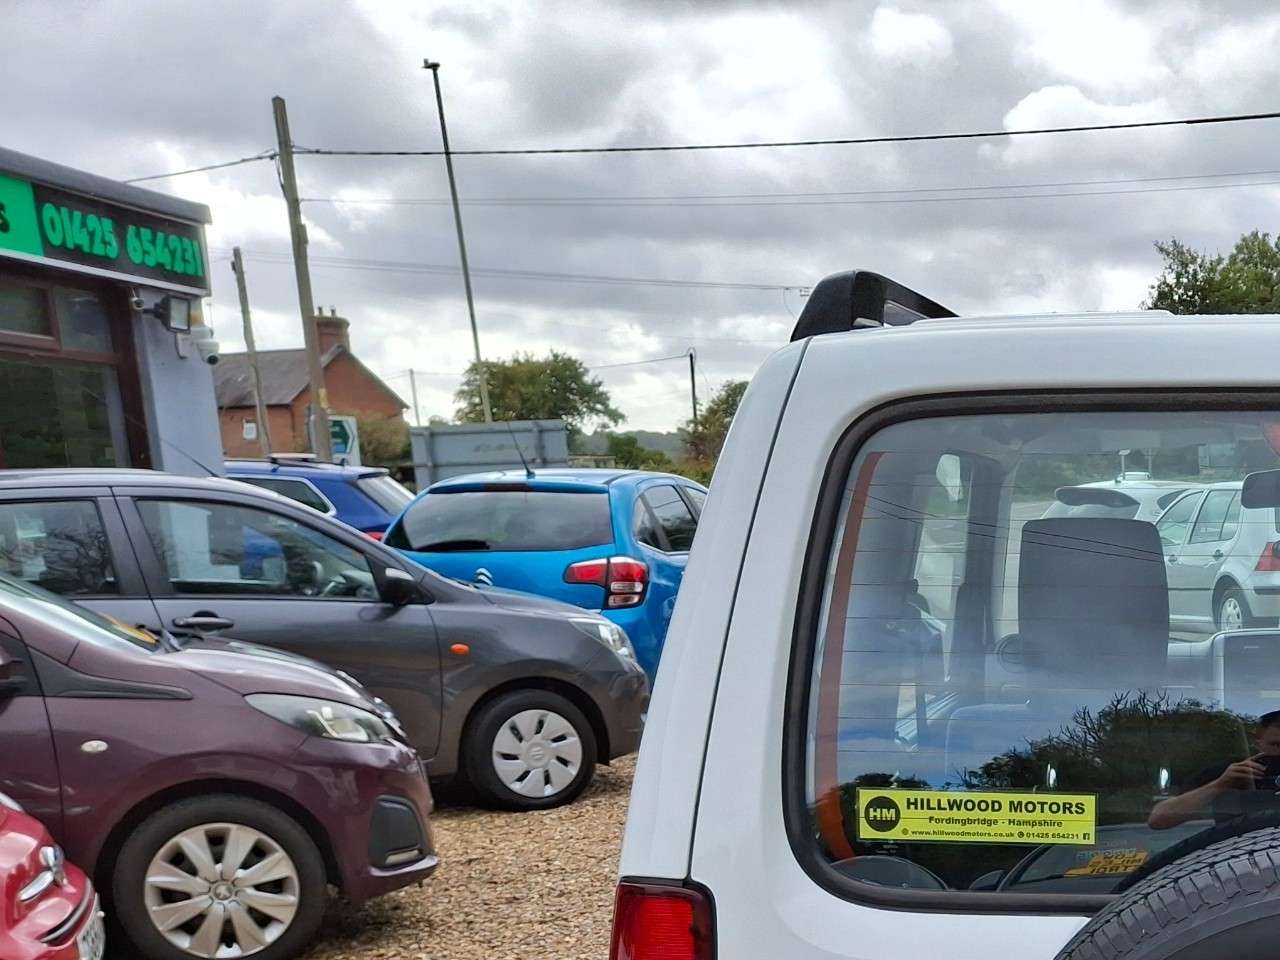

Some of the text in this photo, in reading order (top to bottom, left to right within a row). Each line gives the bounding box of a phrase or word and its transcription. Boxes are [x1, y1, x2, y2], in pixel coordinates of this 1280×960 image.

[42, 203, 119, 259] 01425
[127, 225, 204, 277] 654231
[906, 797, 1085, 815] HILLWOOD MOTORS
[869, 807, 896, 821] HM
[928, 816, 999, 827] Fordingbridge
[1008, 818, 1063, 829] Hampshire
[911, 828, 1015, 838] www.hillwoodmotors.co.uk
[1051, 832, 1080, 840] 654231
